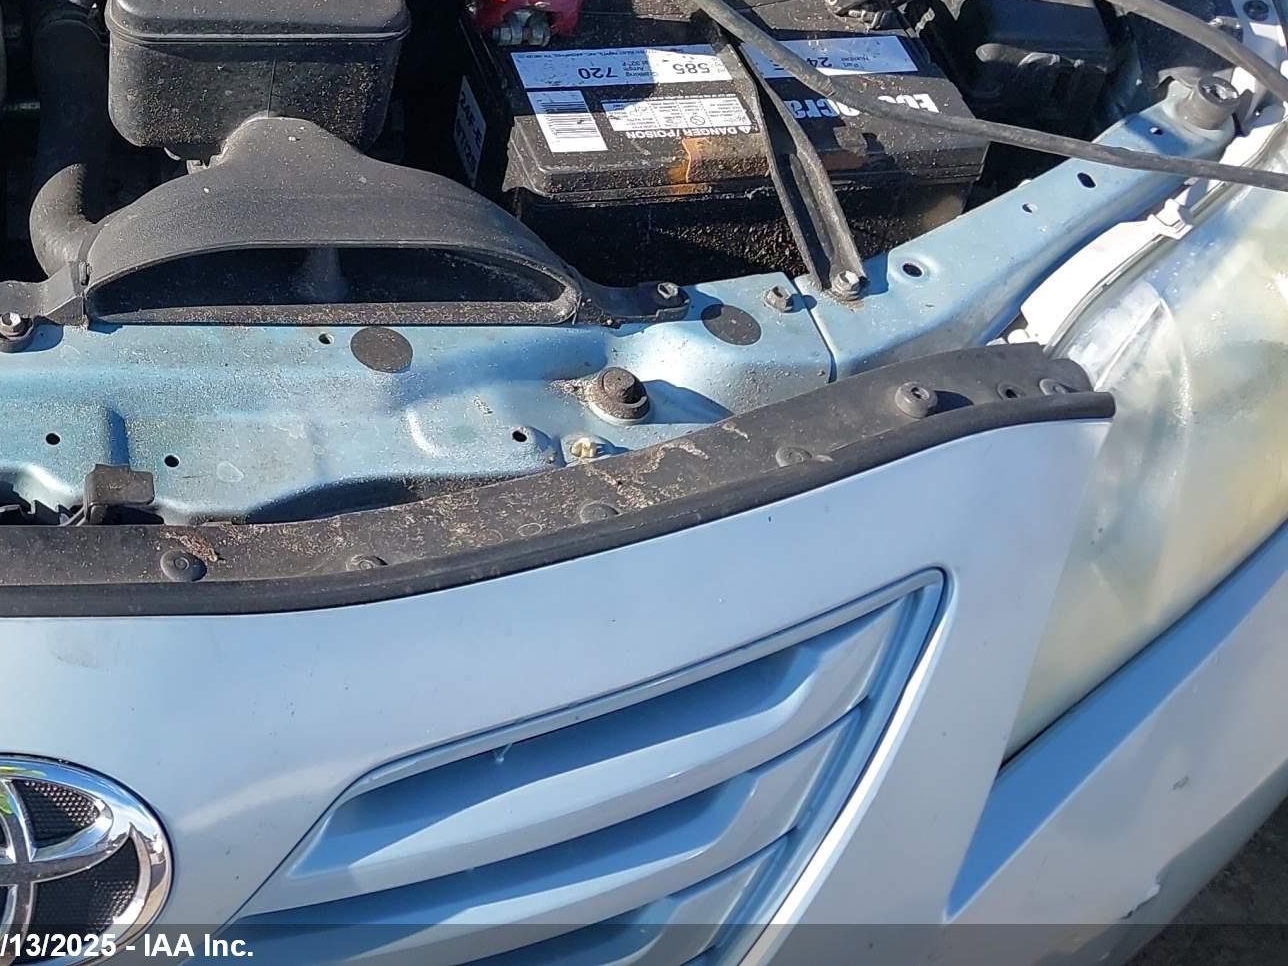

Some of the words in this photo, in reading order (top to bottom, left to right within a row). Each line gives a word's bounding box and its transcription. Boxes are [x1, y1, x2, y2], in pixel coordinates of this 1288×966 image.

[577, 66, 618, 80] 720
[671, 62, 711, 75] 585
[682, 126, 738, 137] DANGER
